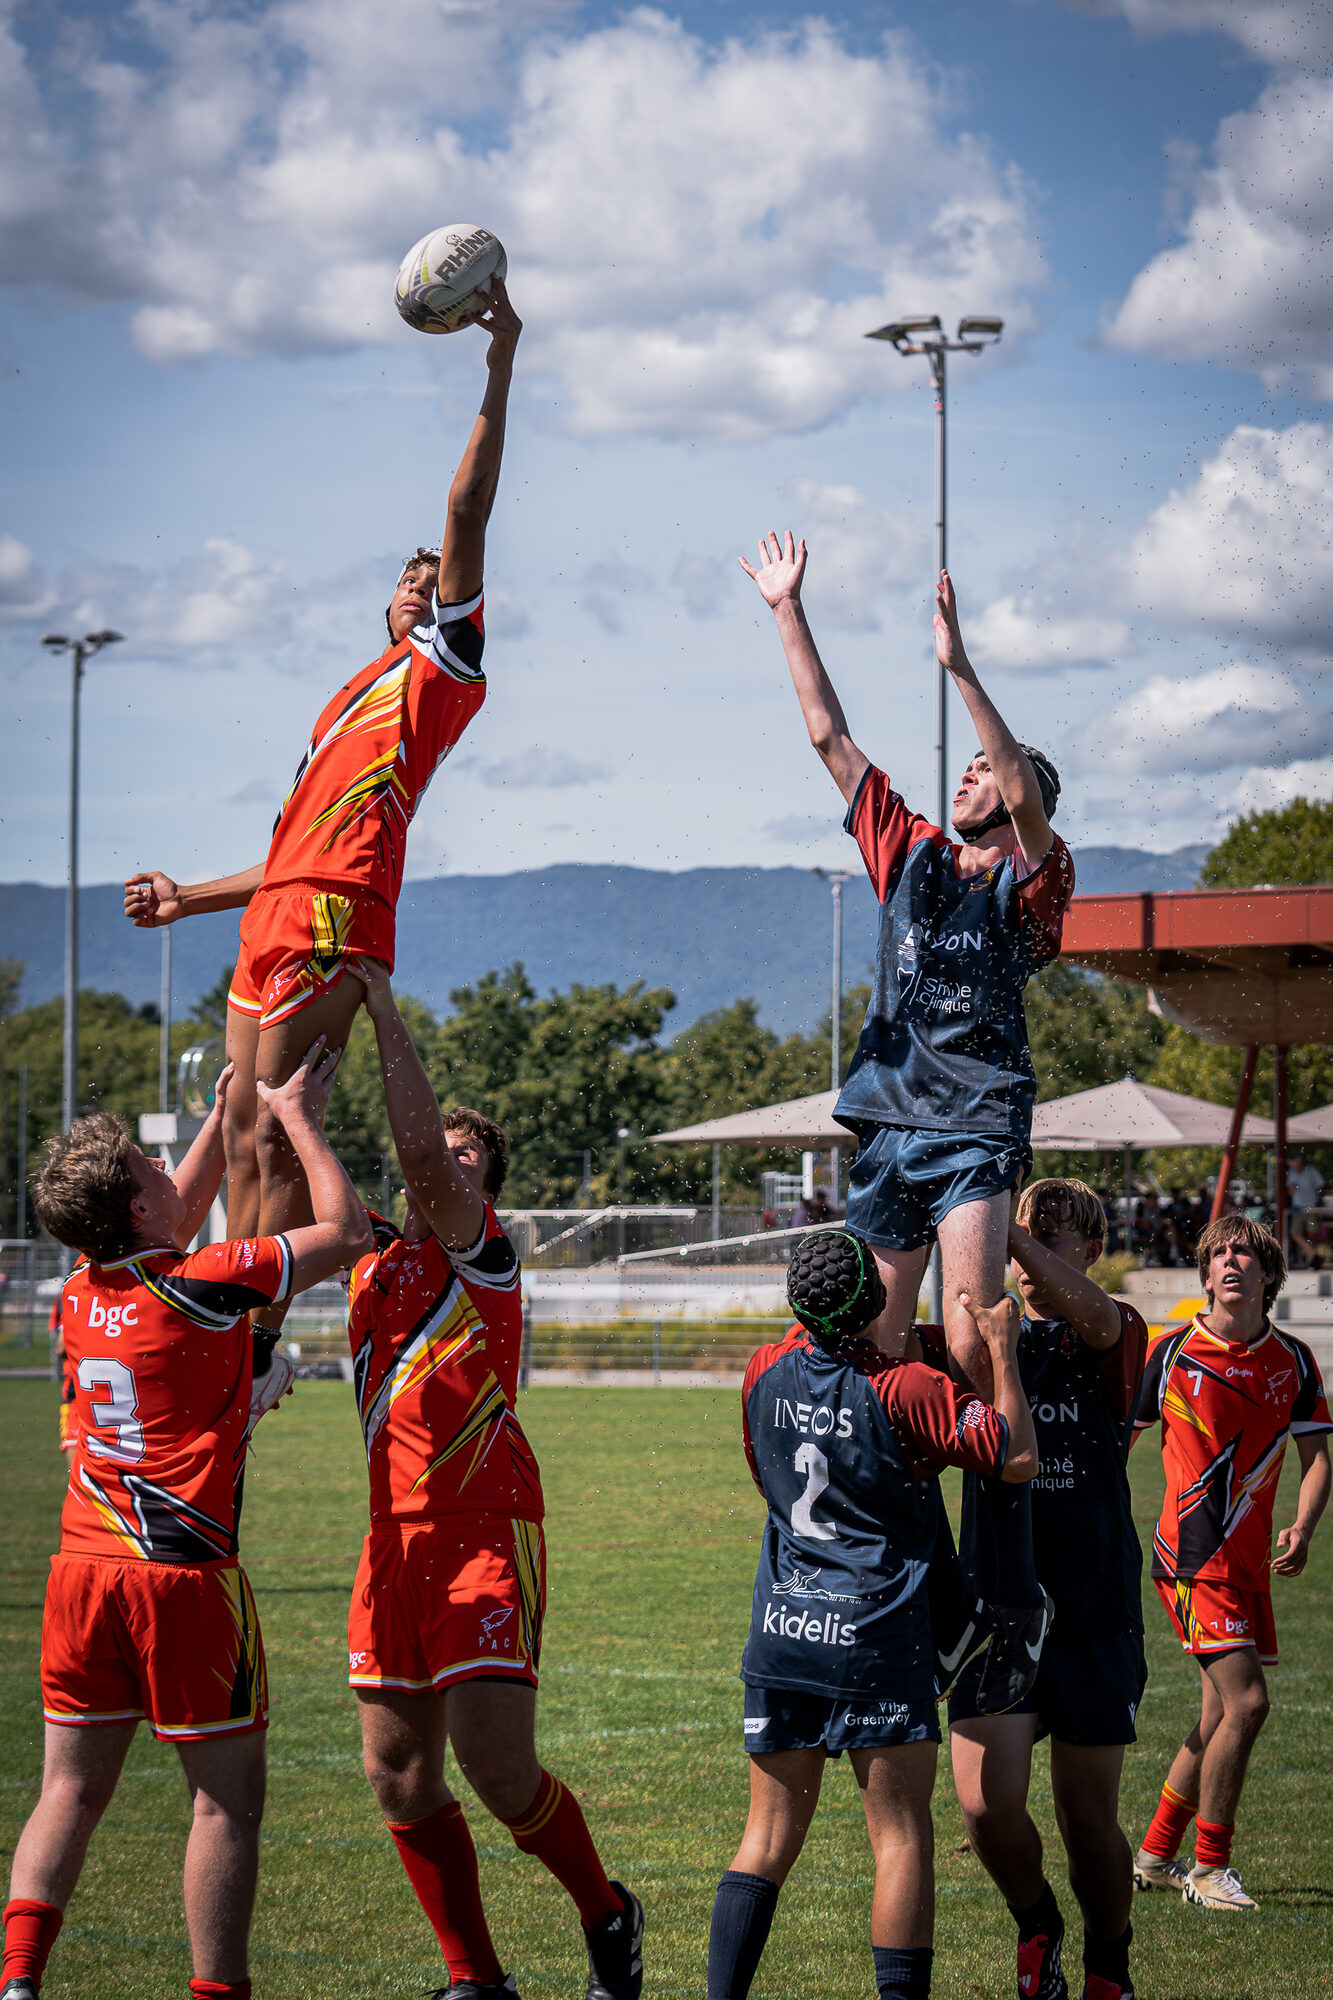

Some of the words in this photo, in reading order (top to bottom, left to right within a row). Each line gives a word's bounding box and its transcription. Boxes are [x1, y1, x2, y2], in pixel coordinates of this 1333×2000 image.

[434, 229, 496, 282] RHINO
[919, 992, 971, 1014] Clinique
[923, 978, 972, 997] Smile
[88, 1296, 139, 1338] bgc
[1187, 1370, 1203, 1396] 7
[77, 1357, 148, 1464] 3
[773, 1397, 854, 1439] INEOS
[790, 1441, 841, 1541] 2
[763, 1602, 857, 1647] kidelis
[1225, 1617, 1250, 1635] bgc
[844, 1712, 911, 1726] Greenway
